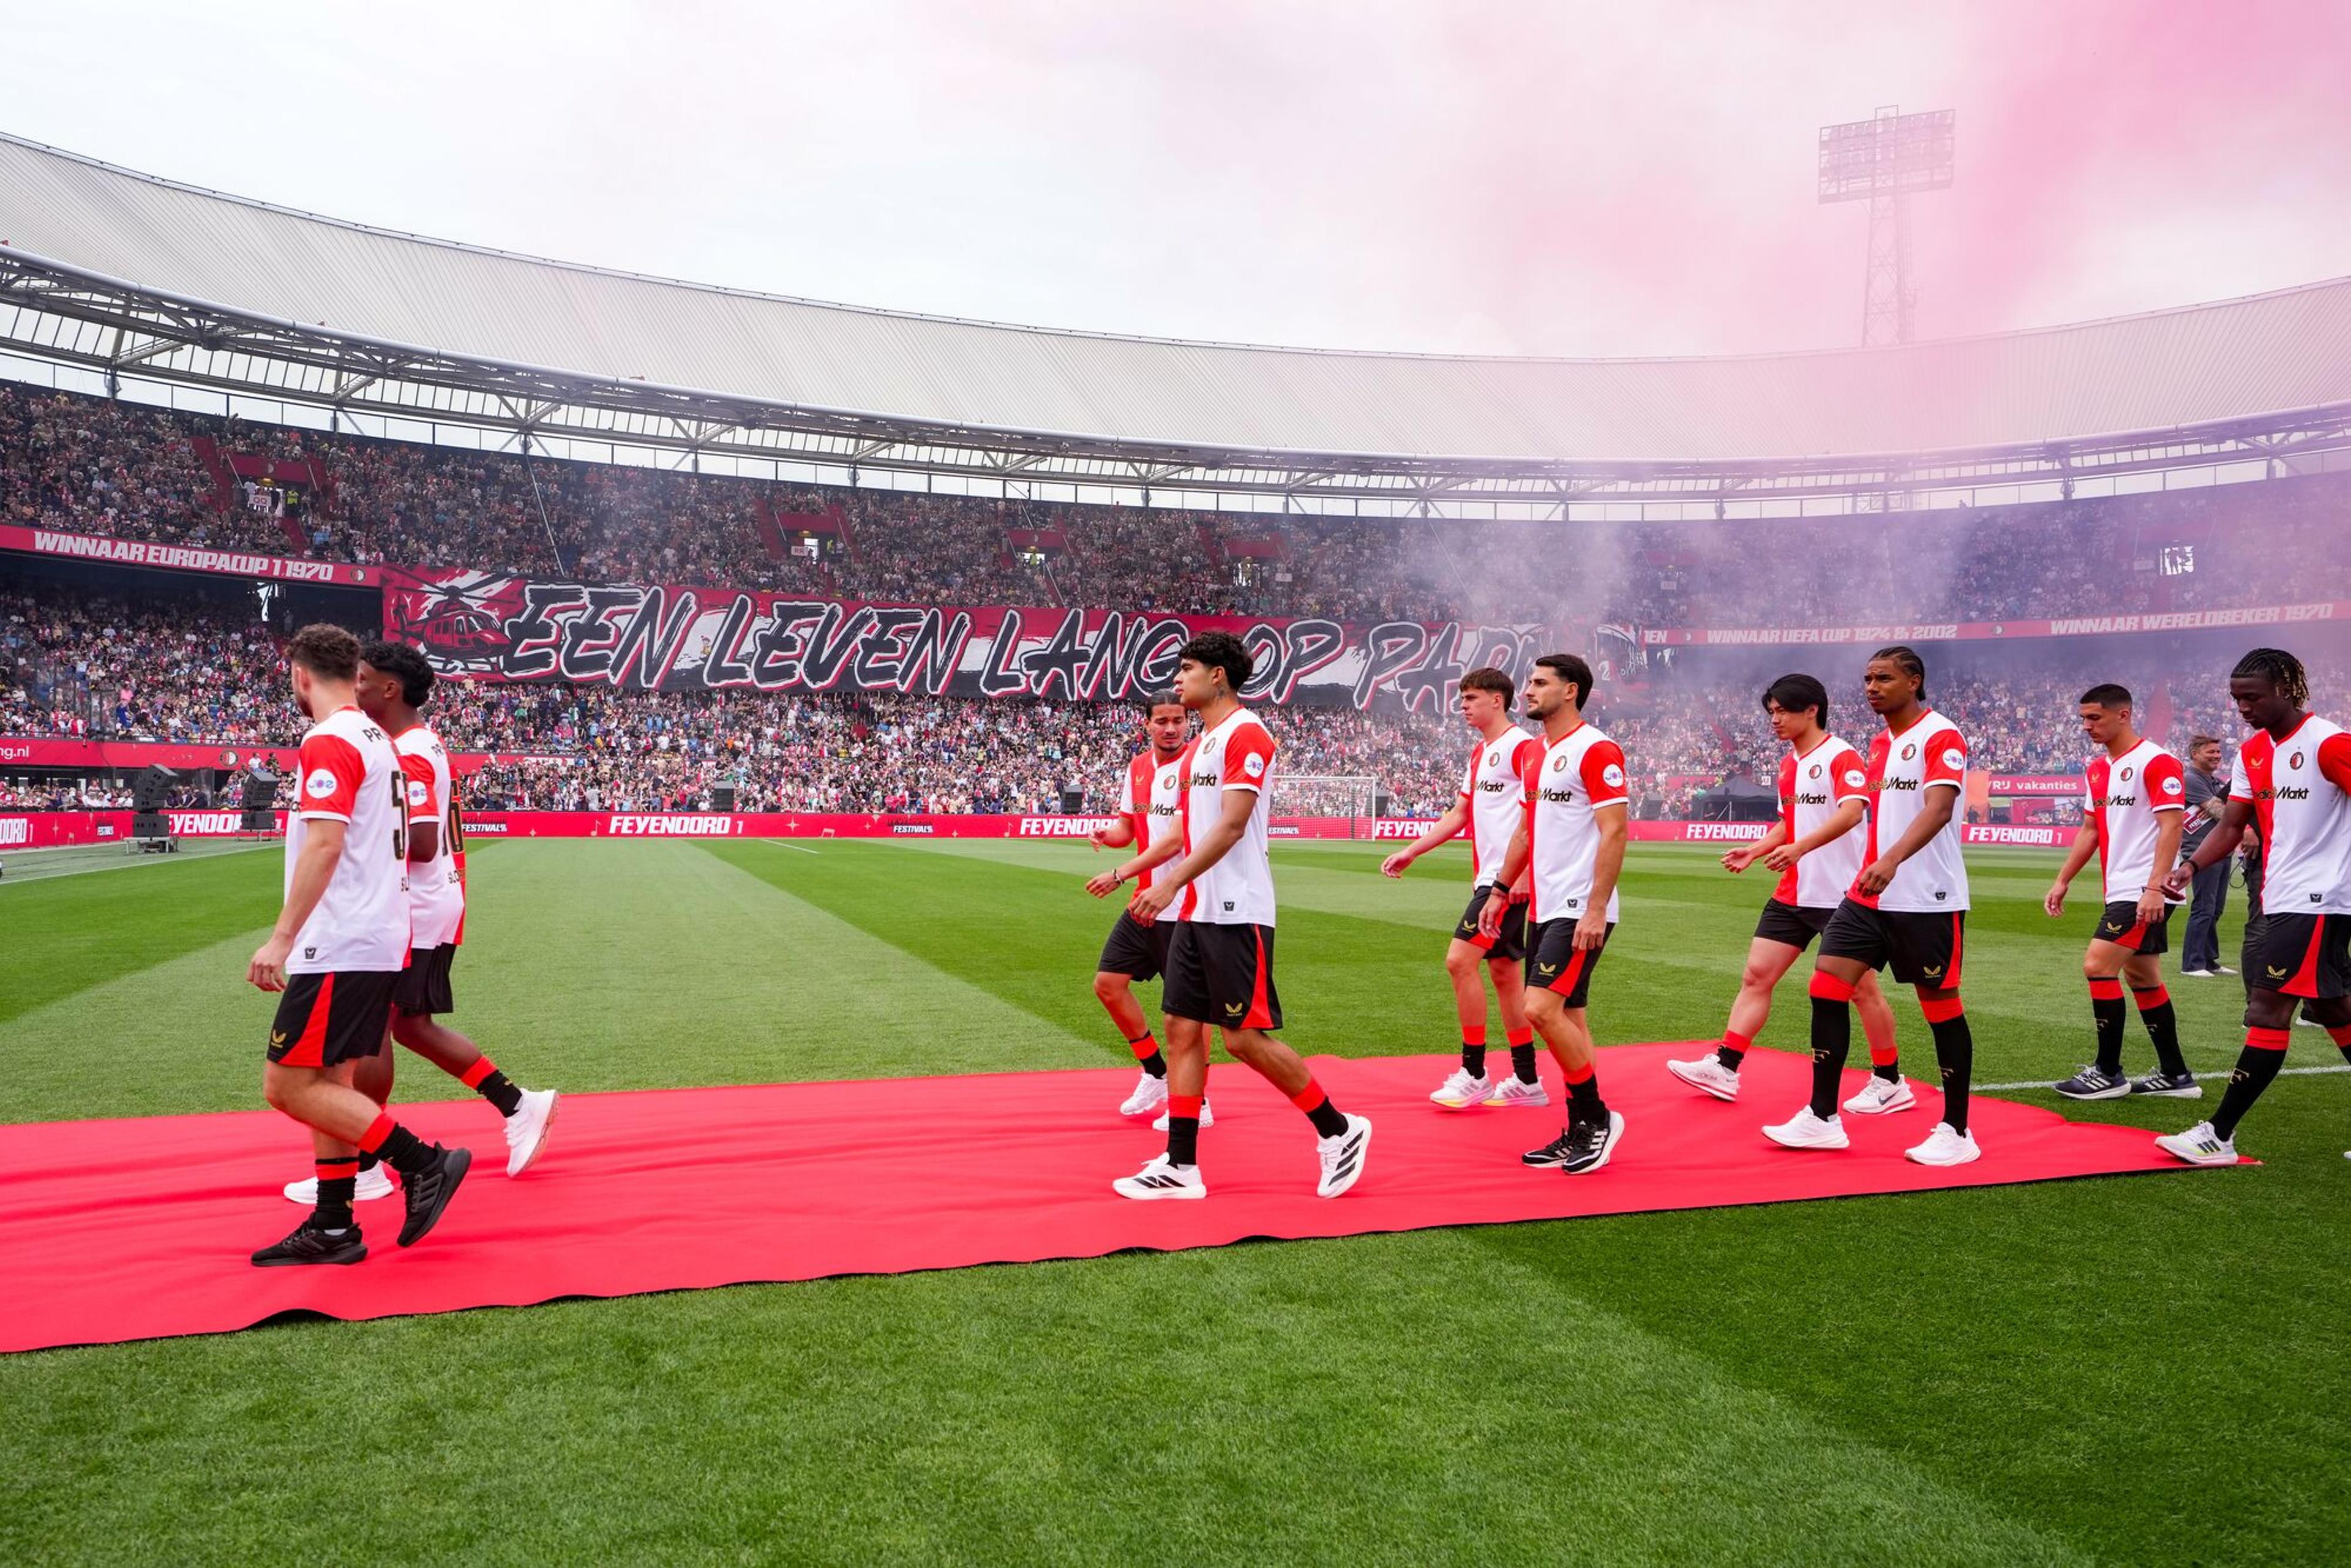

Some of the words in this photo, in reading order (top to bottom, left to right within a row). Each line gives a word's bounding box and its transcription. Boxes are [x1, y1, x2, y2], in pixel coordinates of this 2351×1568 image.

[34, 531, 146, 561] WINNAAR
[146, 545, 269, 574] EUROPACUP
[285, 560, 334, 581] 1970
[2050, 615, 2140, 634] WINNAAR
[2143, 606, 2280, 629] WERELDBEKER
[2284, 603, 2334, 621] 1970
[1707, 629, 1781, 643] WINNAAR
[1782, 629, 1820, 643] UEFA
[1821, 629, 1850, 642] CUP
[1854, 627, 1891, 641] 1974
[1912, 625, 1957, 639] 2002
[503, 584, 697, 689] EEN
[703, 594, 970, 694] LEVEN
[980, 608, 1189, 700] LANG
[1237, 619, 1343, 704] OP
[1477, 781, 1504, 793] Markt
[1886, 776, 1919, 790] Markt
[2016, 780, 2077, 790] vakanties
[1540, 788, 1573, 802] Markt
[1798, 793, 1827, 805] Markt
[2110, 794, 2136, 806] Markt
[2276, 786, 2309, 800] Markt
[1153, 803, 1177, 816] Mark
[609, 816, 731, 834] FEYENOORD
[737, 821, 744, 834] 1
[1686, 823, 1768, 839] FEYENOORD
[1968, 827, 2053, 844] FEYENOORD
